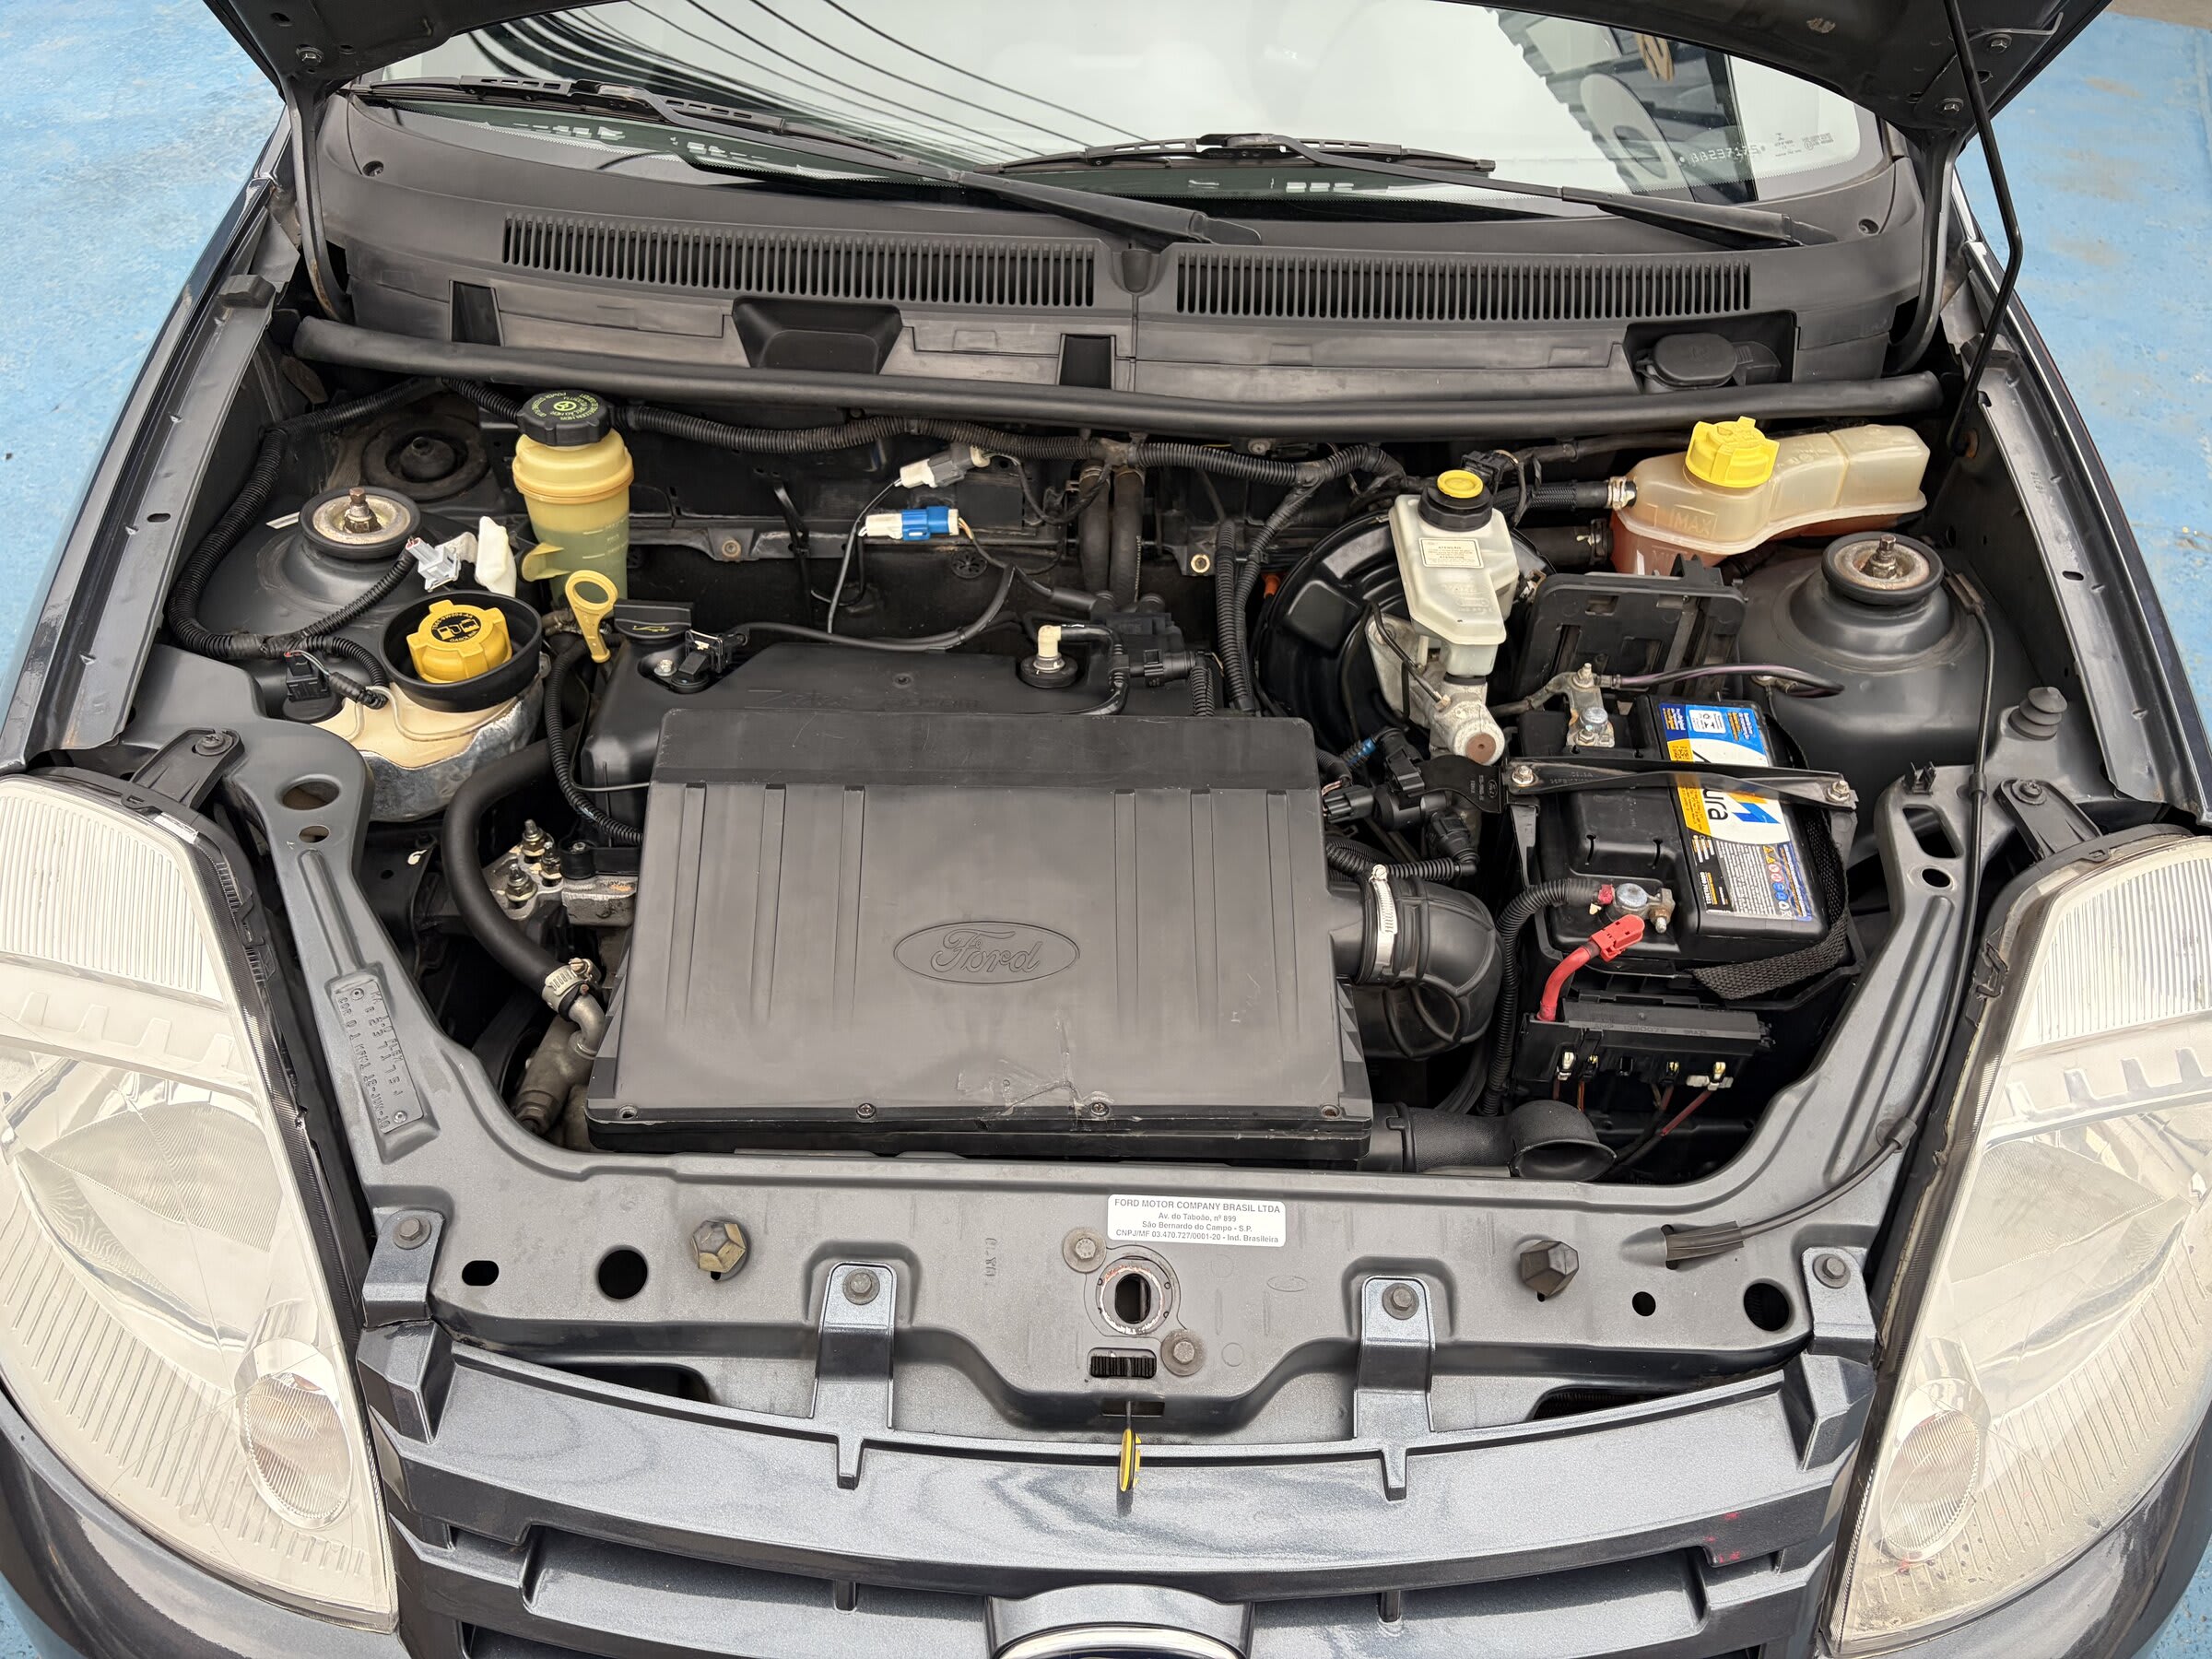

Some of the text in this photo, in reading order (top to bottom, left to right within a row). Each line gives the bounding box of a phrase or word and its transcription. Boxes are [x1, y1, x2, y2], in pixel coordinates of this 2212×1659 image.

[930, 928, 1043, 972] Ford
[1142, 1200, 1174, 1208] MOTOR
[1177, 1201, 1220, 1210] COMPANY
[1223, 1204, 1255, 1212] BRASIL
[1183, 1214, 1212, 1222] Taboão,
[1244, 1235, 1278, 1243] Brasileira
